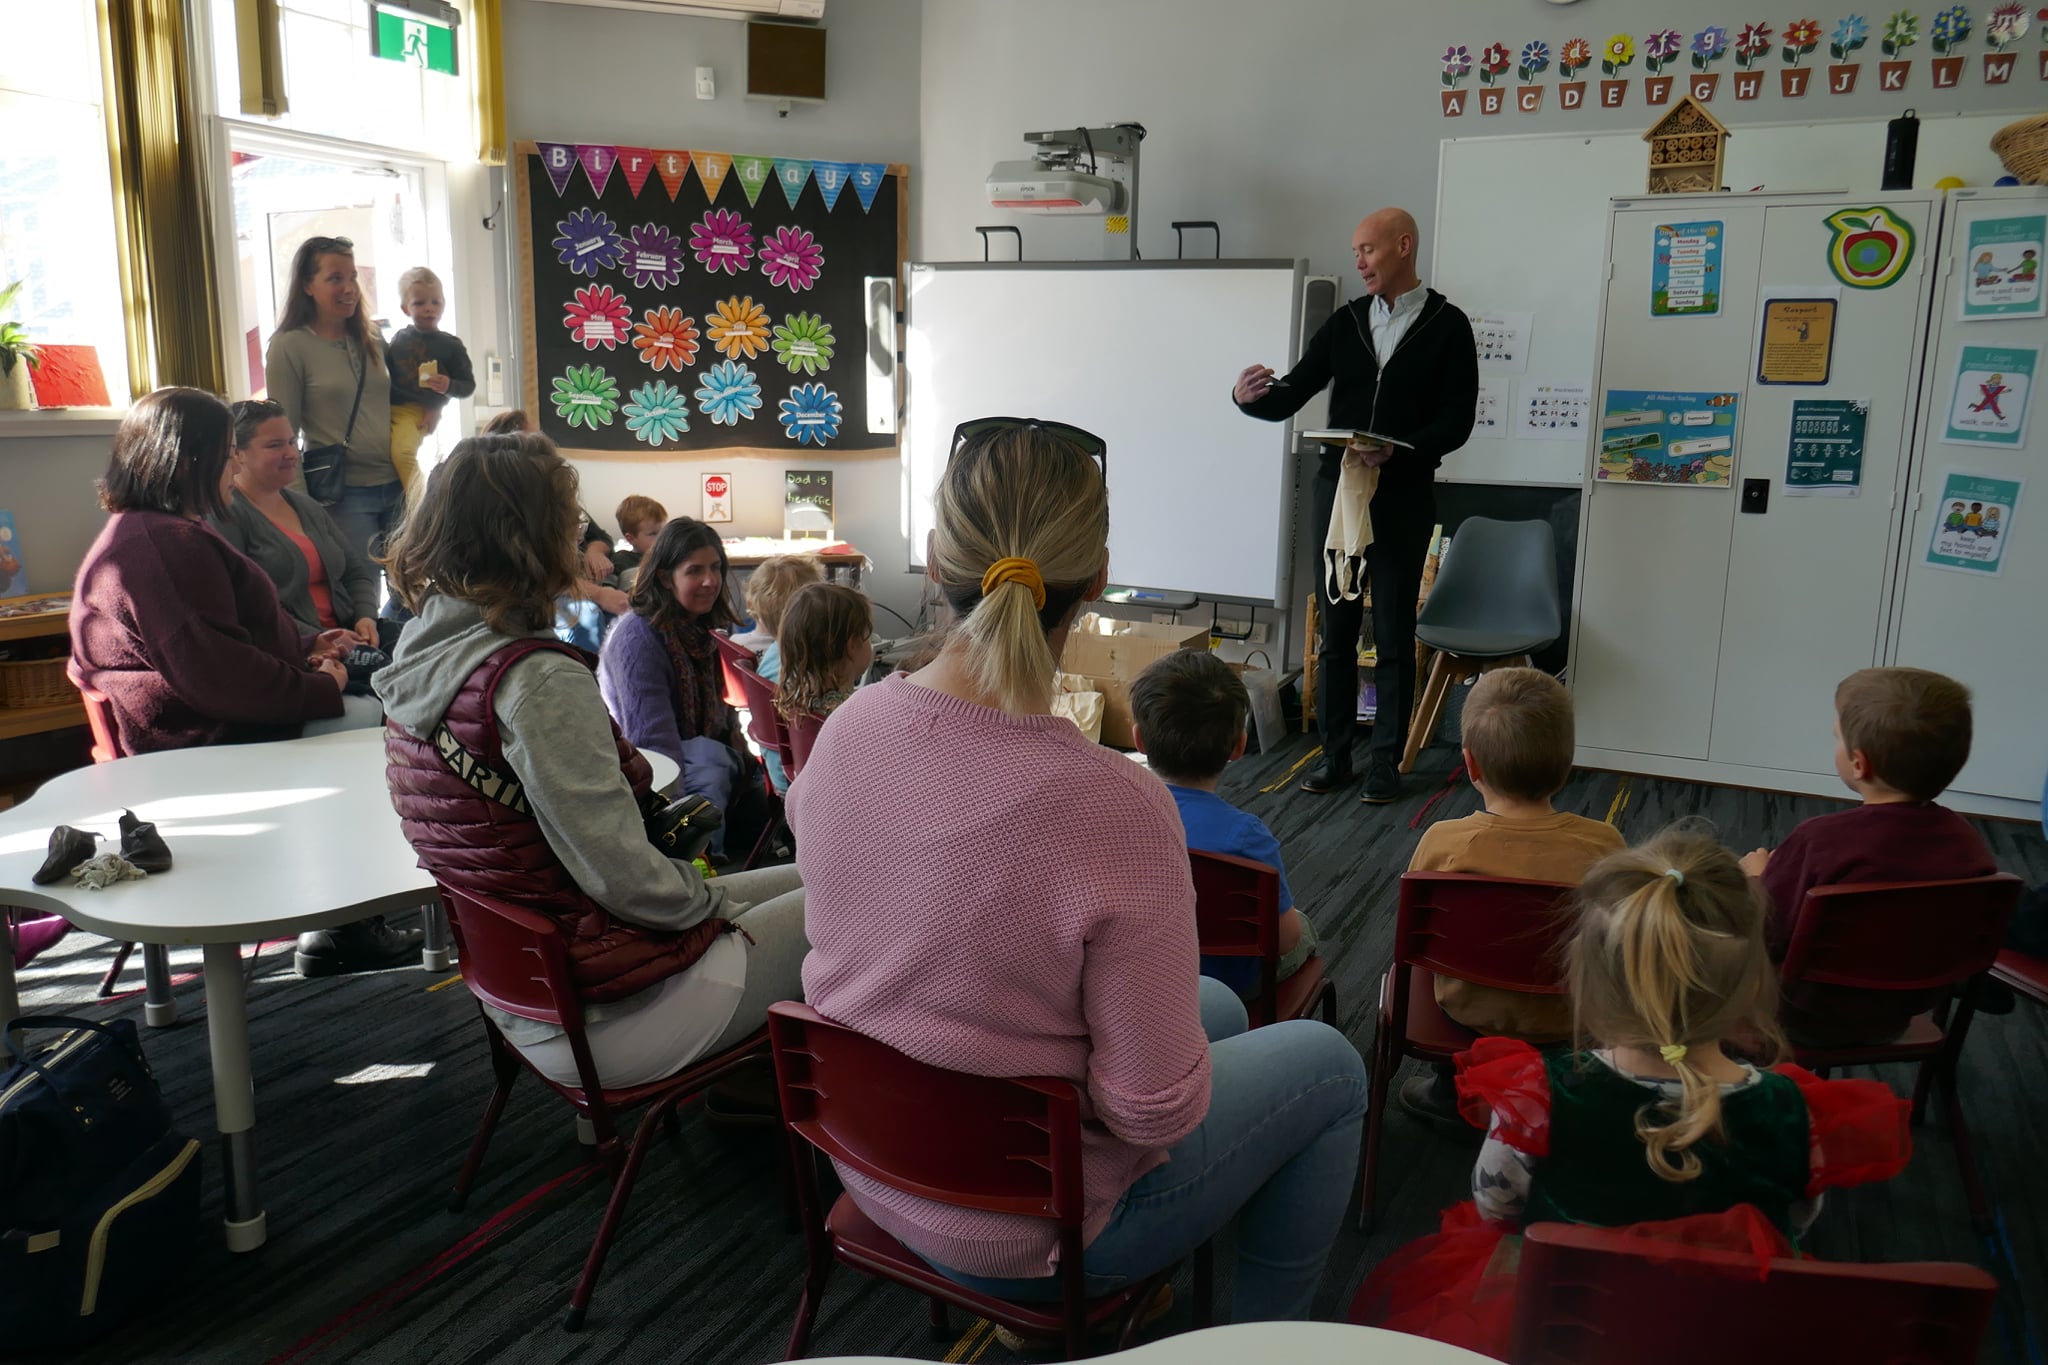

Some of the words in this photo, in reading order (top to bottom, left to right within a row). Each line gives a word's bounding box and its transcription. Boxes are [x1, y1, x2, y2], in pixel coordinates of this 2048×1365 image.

[1490, 48, 1500, 64] b
[1531, 49, 1540, 61] c
[1570, 43, 1581, 58] d
[1613, 43, 1623, 54] e
[1656, 33, 1669, 56] f
[1704, 32, 1715, 50] g
[1749, 30, 1760, 47] h
[1800, 25, 1806, 42] i
[1997, 14, 2017, 29] m
[1447, 98, 1460, 114] A
[1486, 96, 1498, 112] B
[1522, 93, 1535, 109] C
[1565, 90, 1579, 106] D
[1607, 87, 1619, 104] E
[1652, 85, 1664, 102] F
[1695, 83, 1711, 99] G
[1739, 81, 1755, 97] H
[1789, 78, 1799, 94] I
[1835, 73, 1850, 91] J
[1885, 70, 1902, 88] K
[1939, 67, 1952, 85] L
[1986, 63, 2010, 81] M
[552, 148, 872, 189] Birthdays
[575, 235, 602, 250] January
[712, 237, 734, 246] March
[636, 251, 666, 262] February
[783, 253, 800, 263] April
[590, 313, 606, 322] May
[569, 392, 603, 401] September
[1677, 395, 1697, 403] Today
[787, 474, 811, 485] Dad
[817, 474, 828, 486] is
[706, 483, 727, 492] STOP
[1954, 541, 1976, 550] hands
